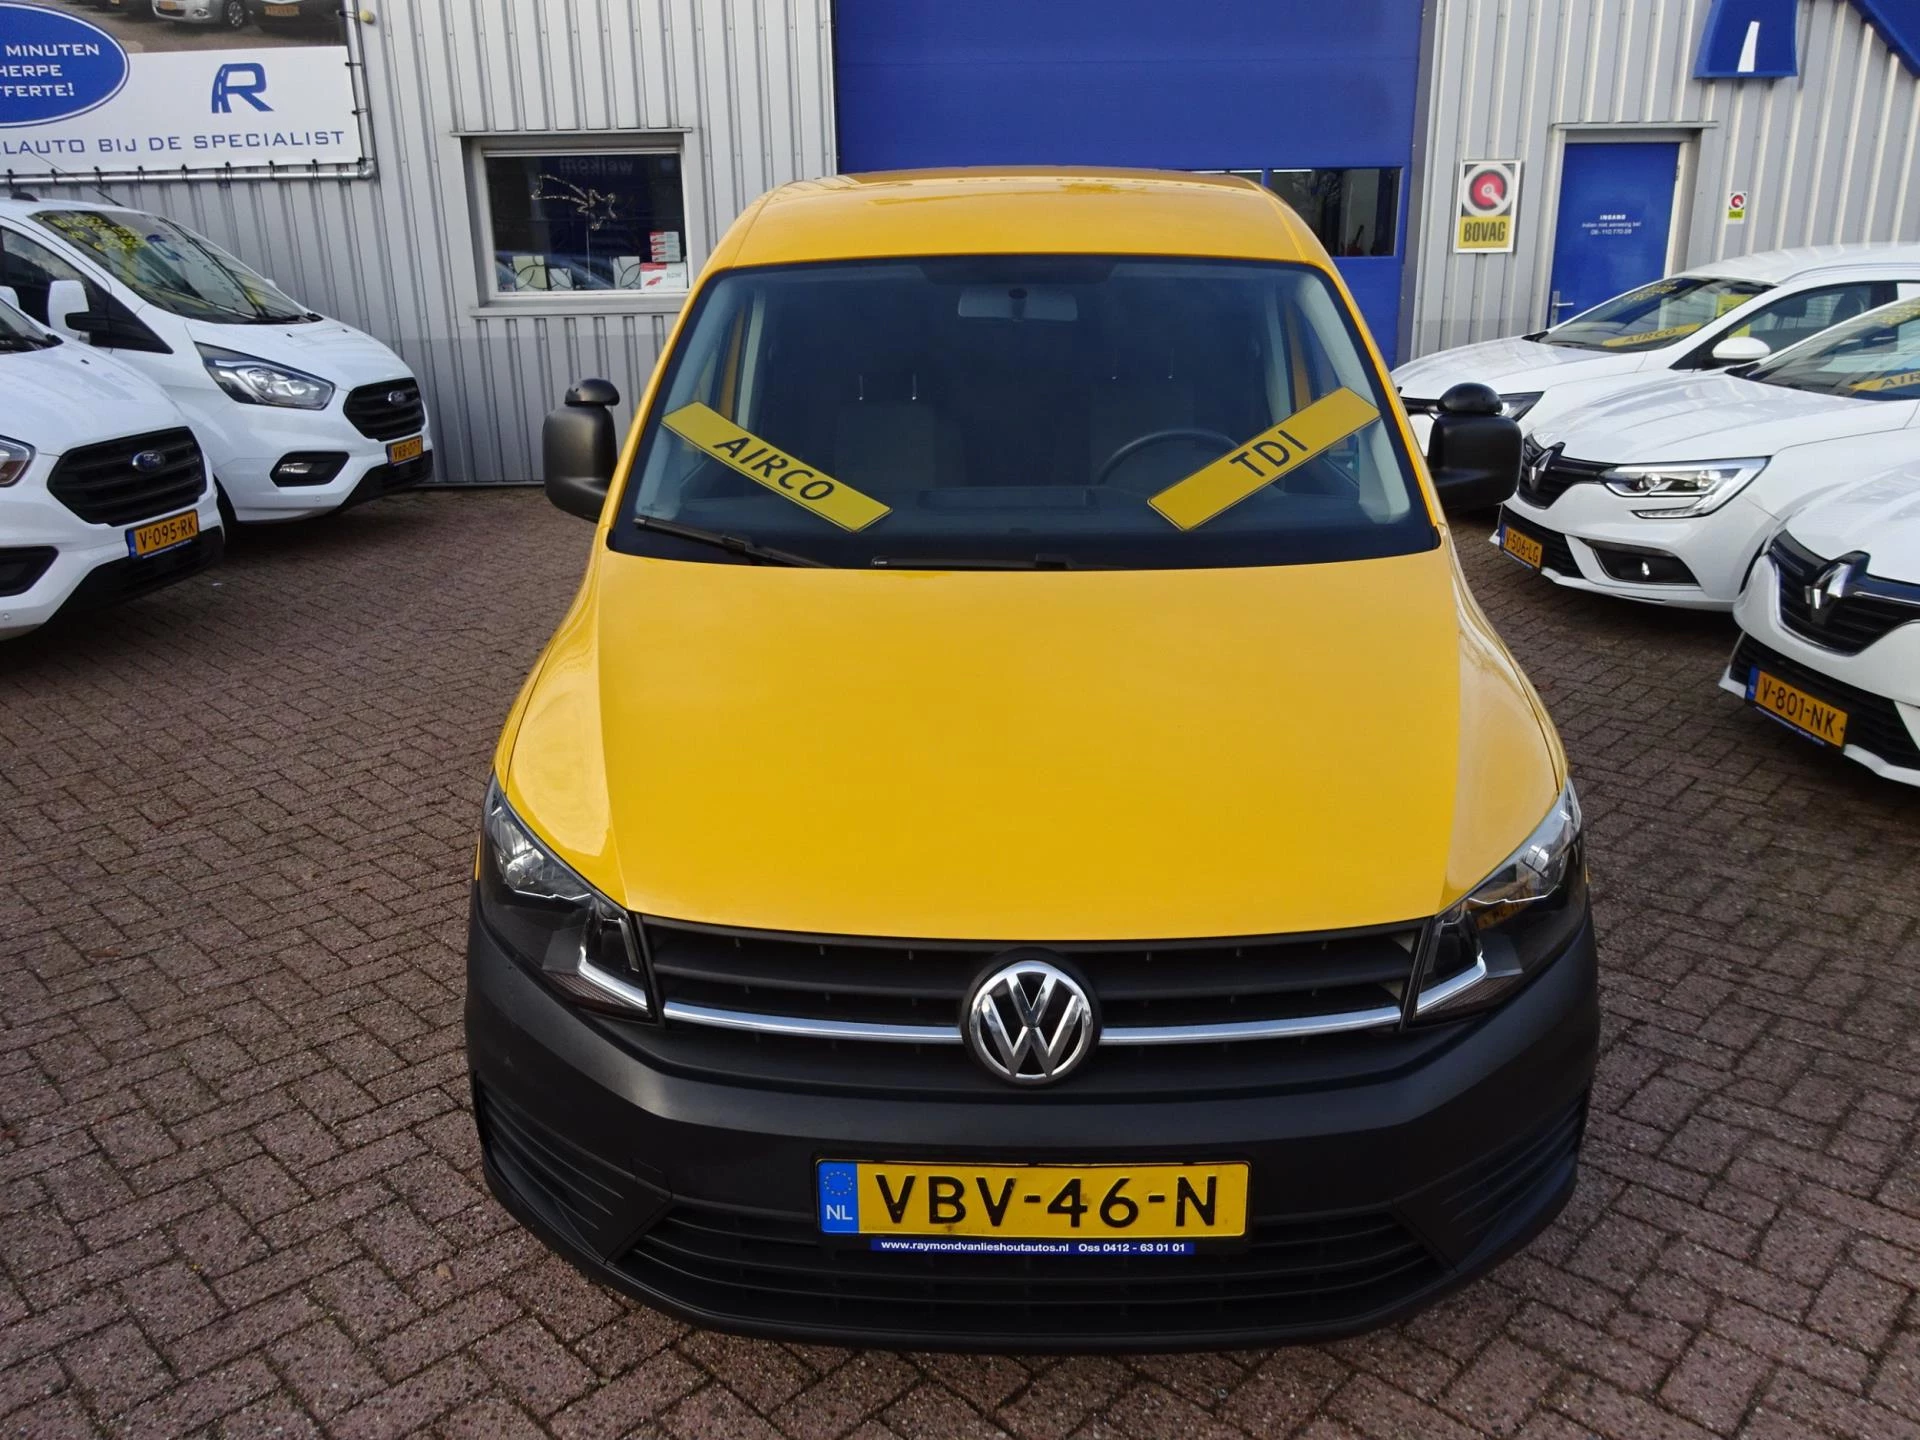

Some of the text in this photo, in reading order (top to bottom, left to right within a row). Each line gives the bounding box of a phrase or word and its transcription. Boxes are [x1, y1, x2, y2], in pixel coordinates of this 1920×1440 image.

[5, 43, 100, 57] MINUTEN
[0, 82, 75, 97] FERTE!
[0, 131, 344, 154] LAUTO BIJ DE SPECIALIST
[1463, 221, 1507, 242] BOVAG
[1228, 429, 1309, 477] TDI
[712, 437, 835, 500] AIRCO
[138, 514, 196, 550] V-095-RK
[1761, 678, 1837, 739] V-801-NK
[826, 1204, 853, 1221] NL
[875, 1174, 1217, 1228] VBV-46-N
[880, 1240, 1069, 1253] www.raymondvanlieshoutautos.nl
[1078, 1243, 1100, 1253] Oss
[1103, 1243, 1130, 1252] 0412
[1140, 1243, 1154, 1252] 63
[1156, 1243, 1170, 1252] 01
[1172, 1243, 1186, 1252] 01
